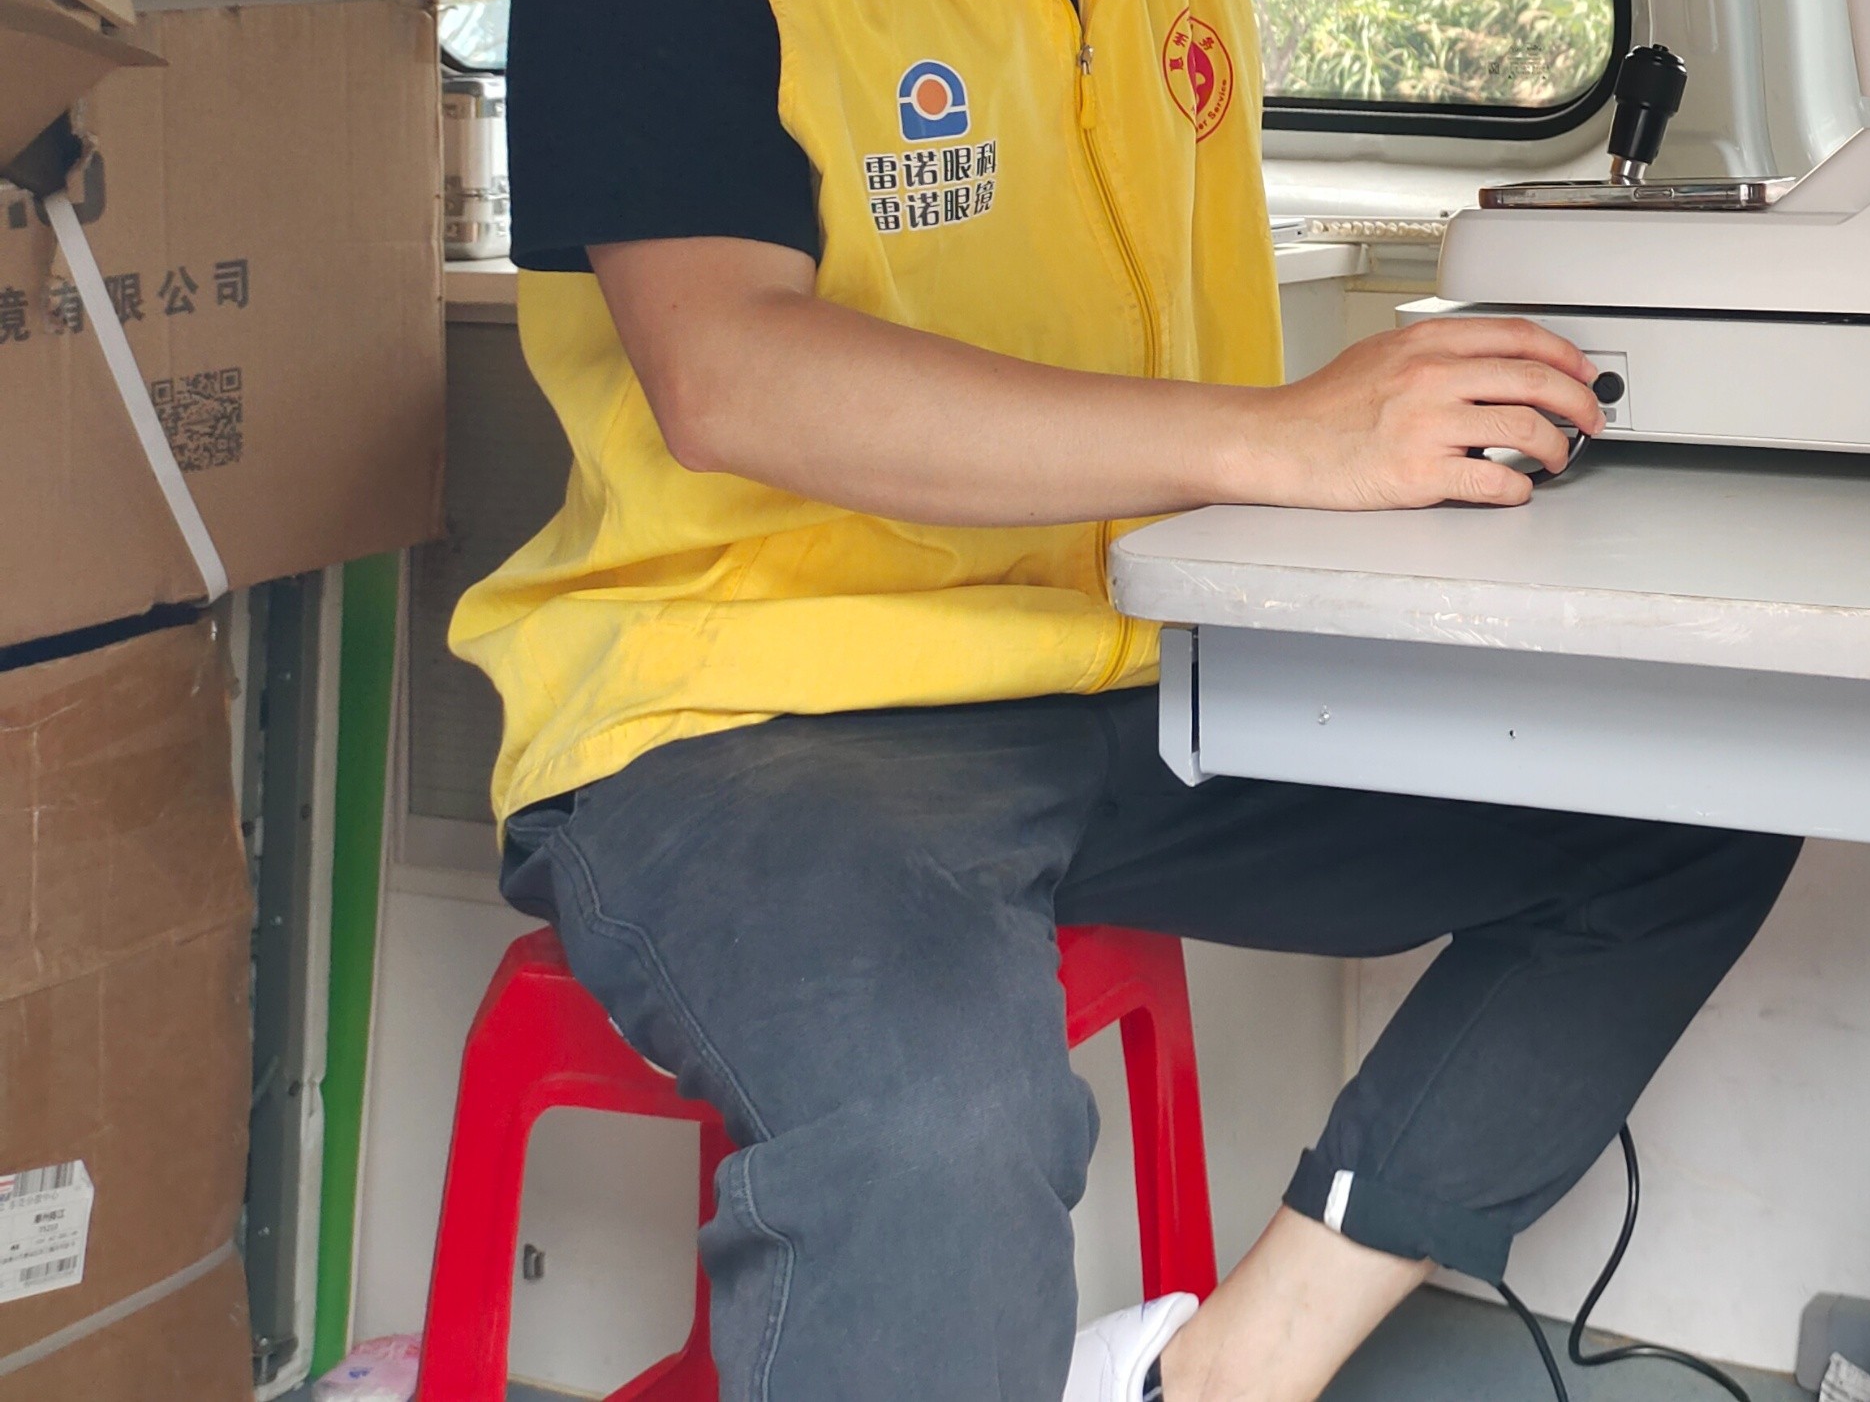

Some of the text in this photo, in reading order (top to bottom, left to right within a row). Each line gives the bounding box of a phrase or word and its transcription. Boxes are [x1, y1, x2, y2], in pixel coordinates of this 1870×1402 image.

[865, 139, 996, 191] 雷诺眼科
[870, 180, 995, 231] 雷诺眼镜
